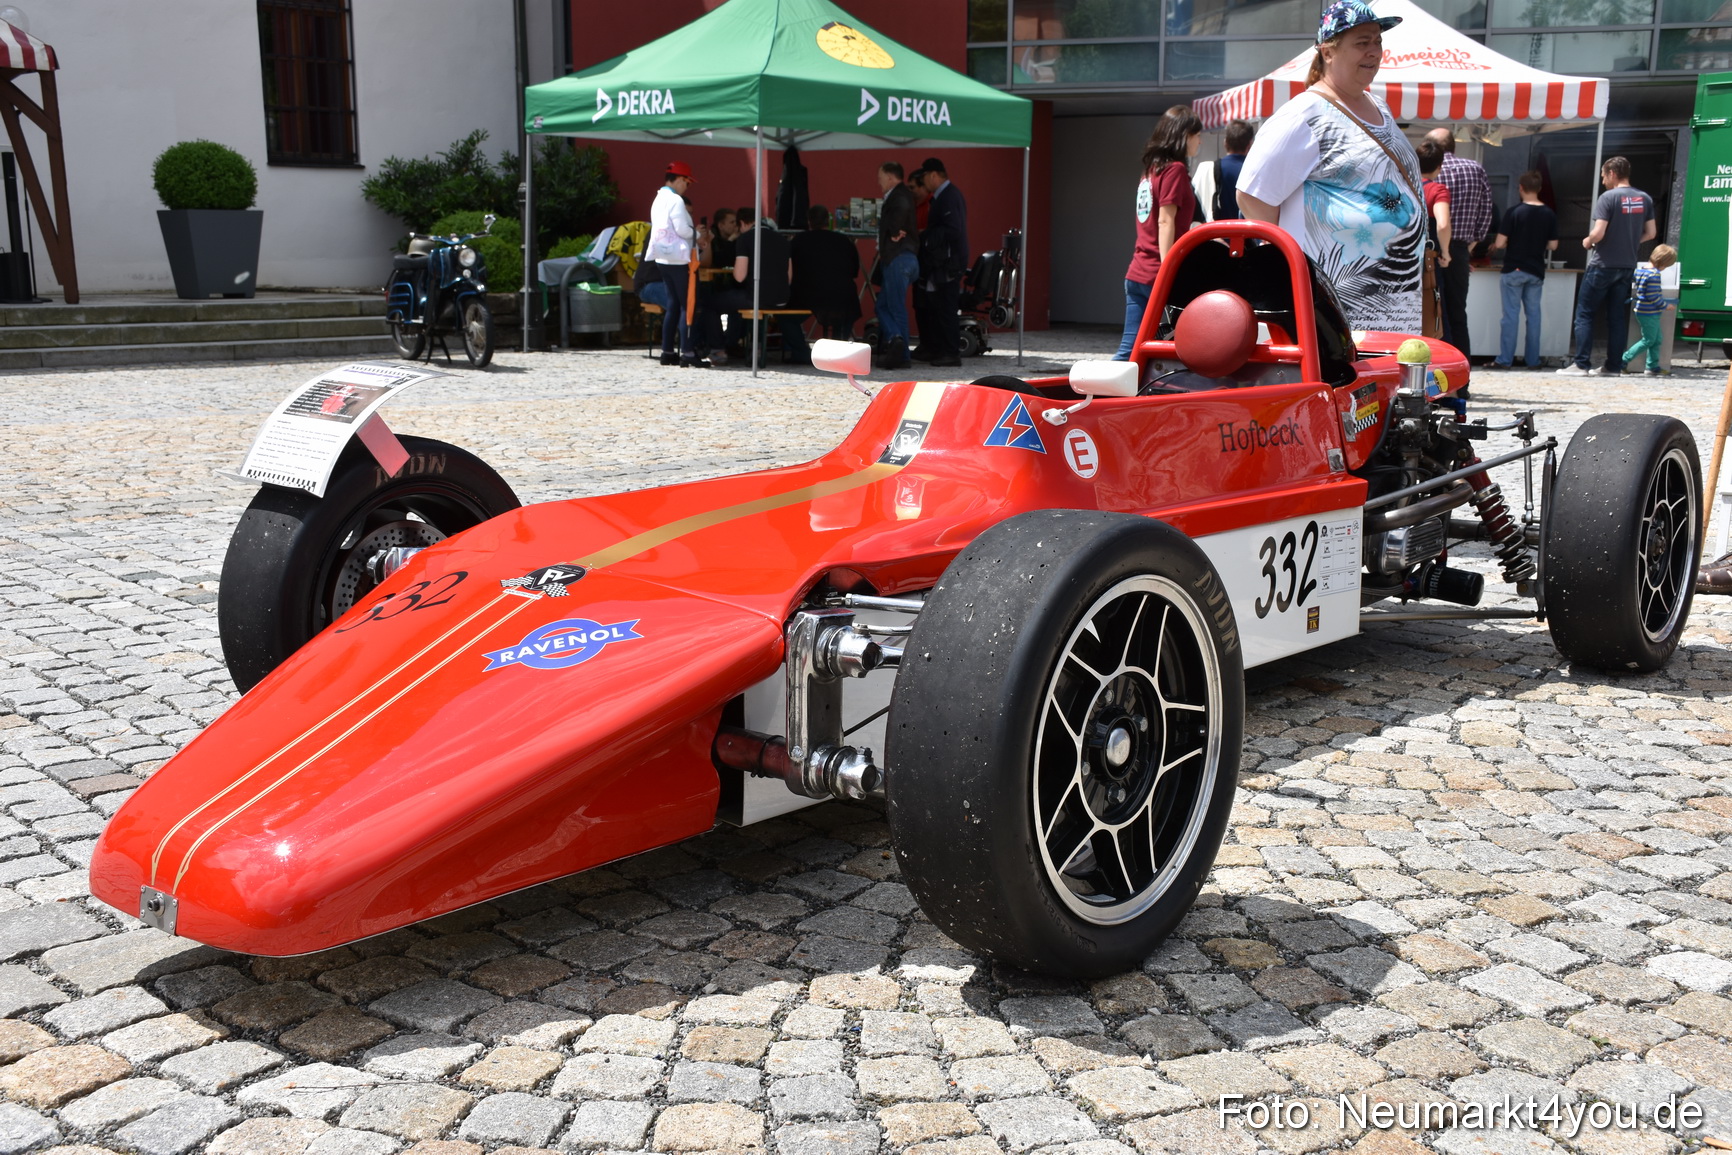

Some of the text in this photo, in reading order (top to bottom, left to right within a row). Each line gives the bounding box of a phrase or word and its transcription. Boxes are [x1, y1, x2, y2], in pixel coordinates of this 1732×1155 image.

[1381, 46, 1471, 66] hmeier's
[1429, 60, 1480, 71] IMBISS
[617, 88, 676, 116] DEKRA
[887, 96, 952, 126] DEKRA
[1069, 436, 1093, 471] E
[1217, 417, 1304, 456] Hofbeck
[374, 453, 447, 489] AON
[1255, 520, 1319, 620] 332
[334, 571, 469, 634] 332
[1193, 569, 1239, 656] AVON
[500, 627, 624, 663] RAVENOL
